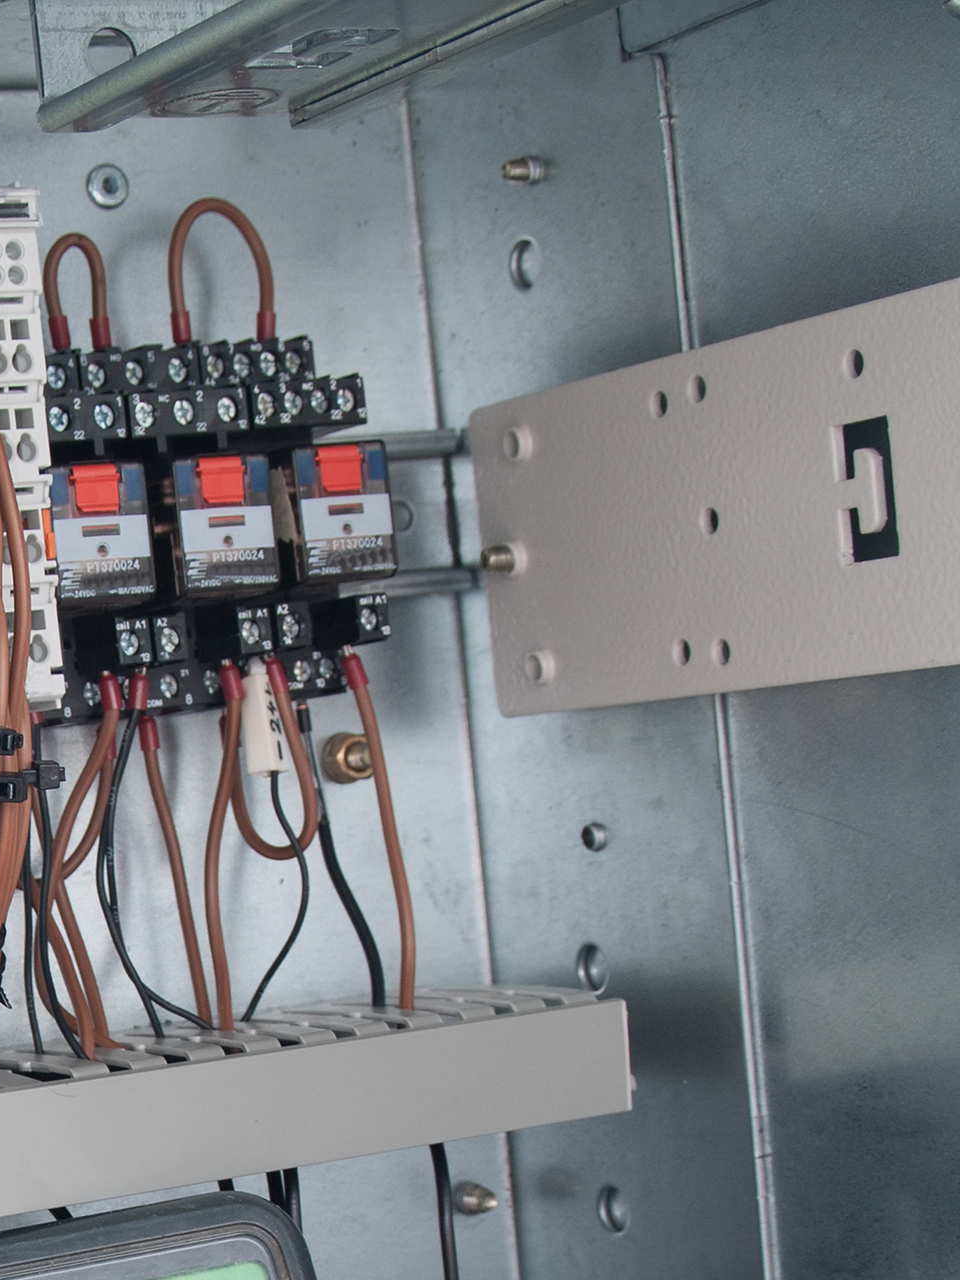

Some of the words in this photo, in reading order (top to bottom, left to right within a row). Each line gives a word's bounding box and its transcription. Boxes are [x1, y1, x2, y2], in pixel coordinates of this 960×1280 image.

[73, 430, 86, 440] 22
[332, 536, 383, 550] PT370024
[212, 549, 265, 562] PT370024
[86, 559, 141, 573] PT370024
[375, 594, 388, 605] A1
[256, 608, 268, 618] A1
[276, 604, 289, 614] A2
[115, 622, 130, 631] coil
[134, 620, 147, 629] A1
[156, 617, 168, 627] A2
[140, 652, 150, 662] 13
